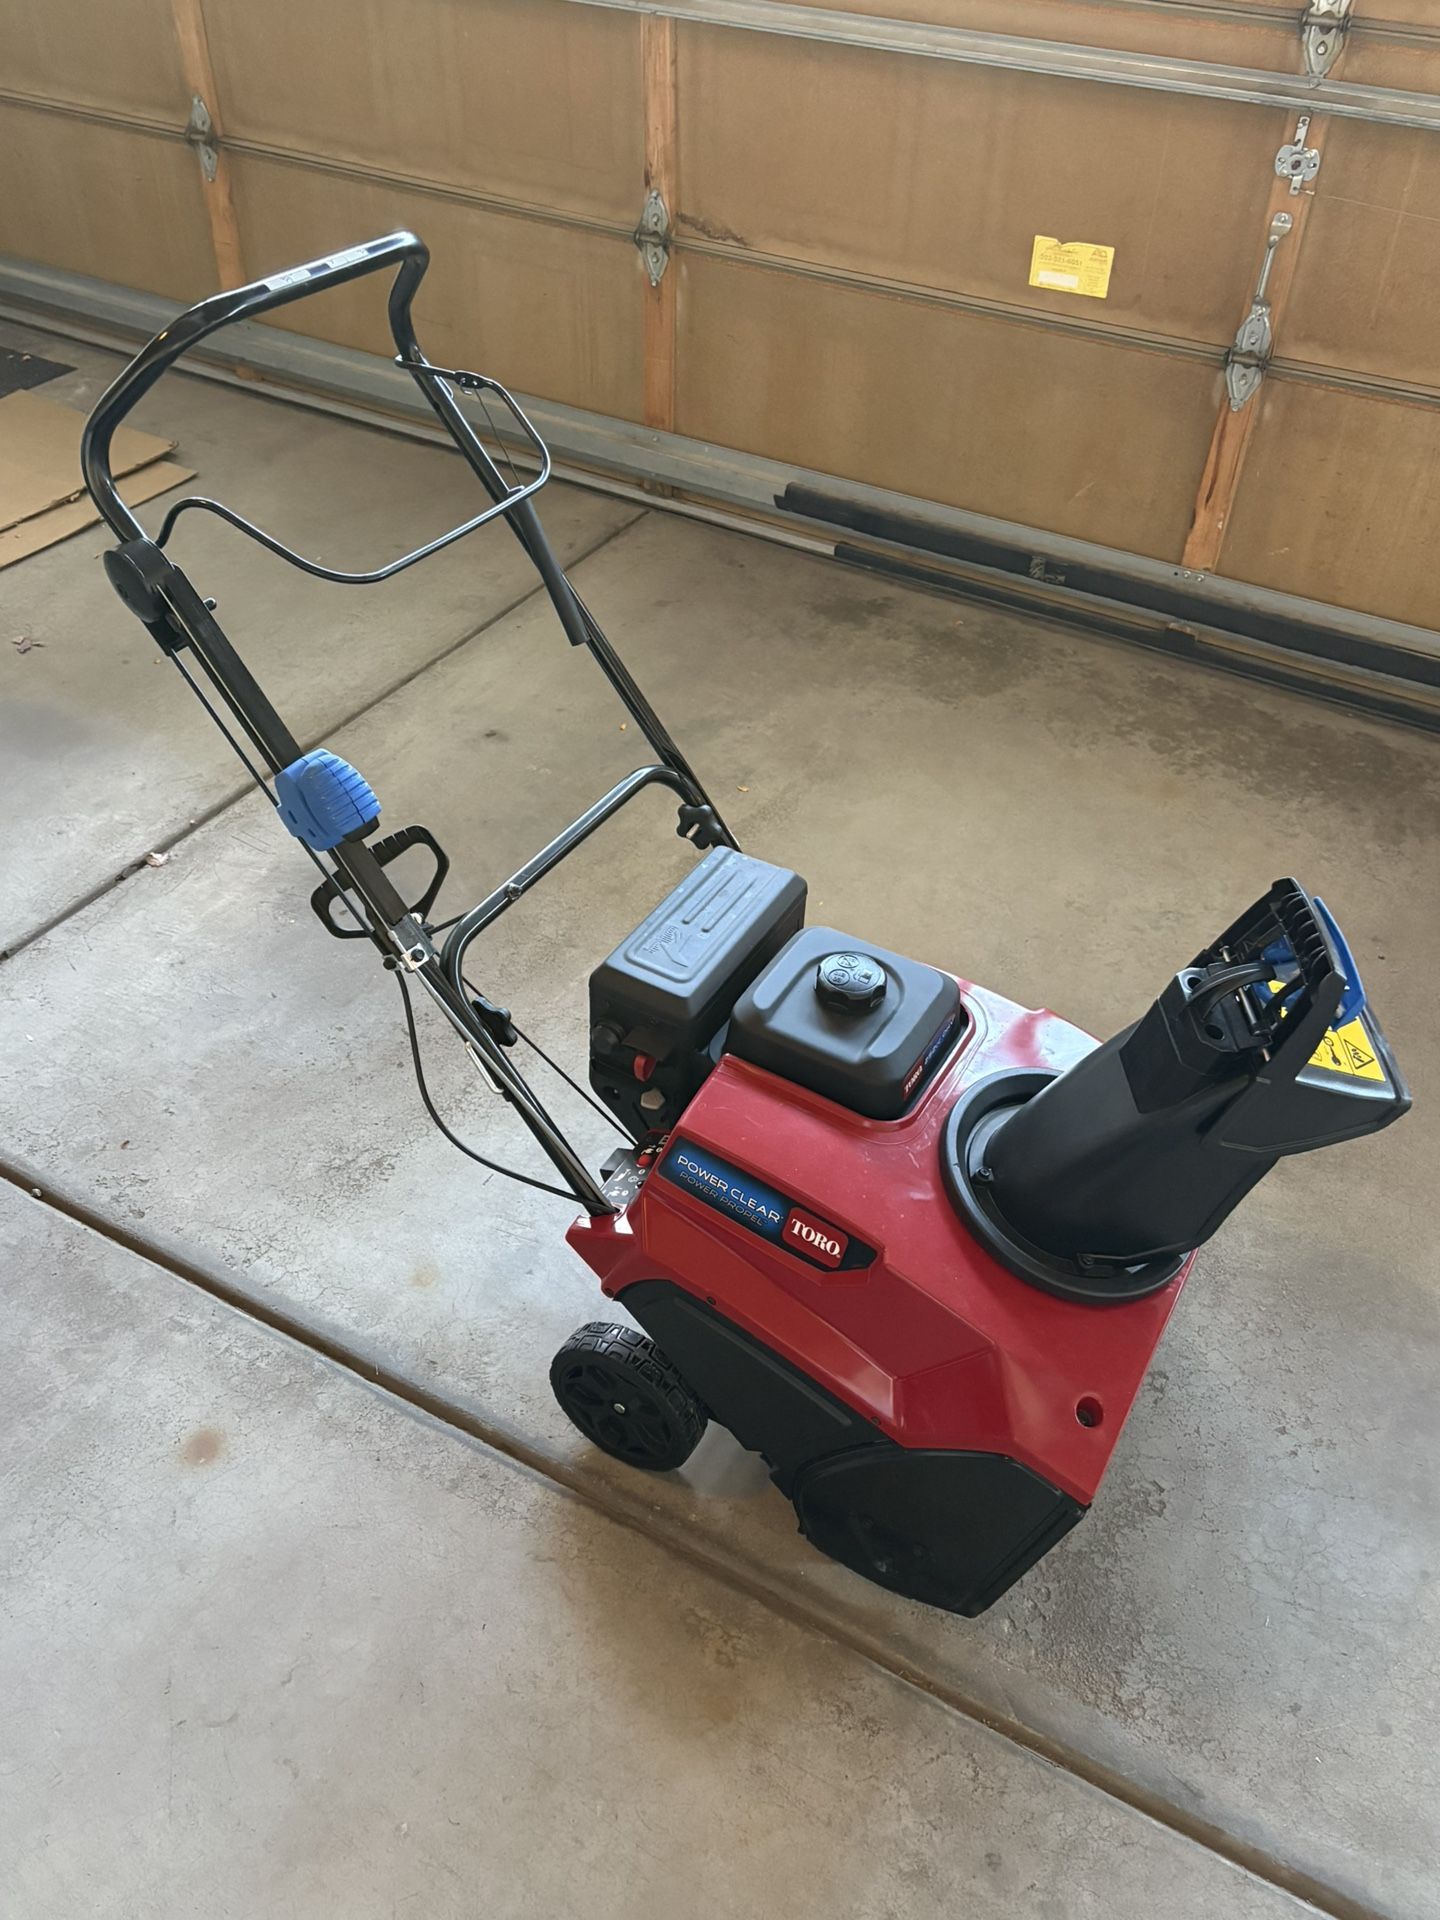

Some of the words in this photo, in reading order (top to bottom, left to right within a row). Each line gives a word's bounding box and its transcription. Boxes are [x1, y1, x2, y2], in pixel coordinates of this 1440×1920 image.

[678, 1155, 729, 1193] POWER
[730, 1187, 782, 1224] CLEAR
[679, 1170, 719, 1199] POWER
[720, 1195, 765, 1227] PROPEL
[790, 1217, 841, 1258] TORO
